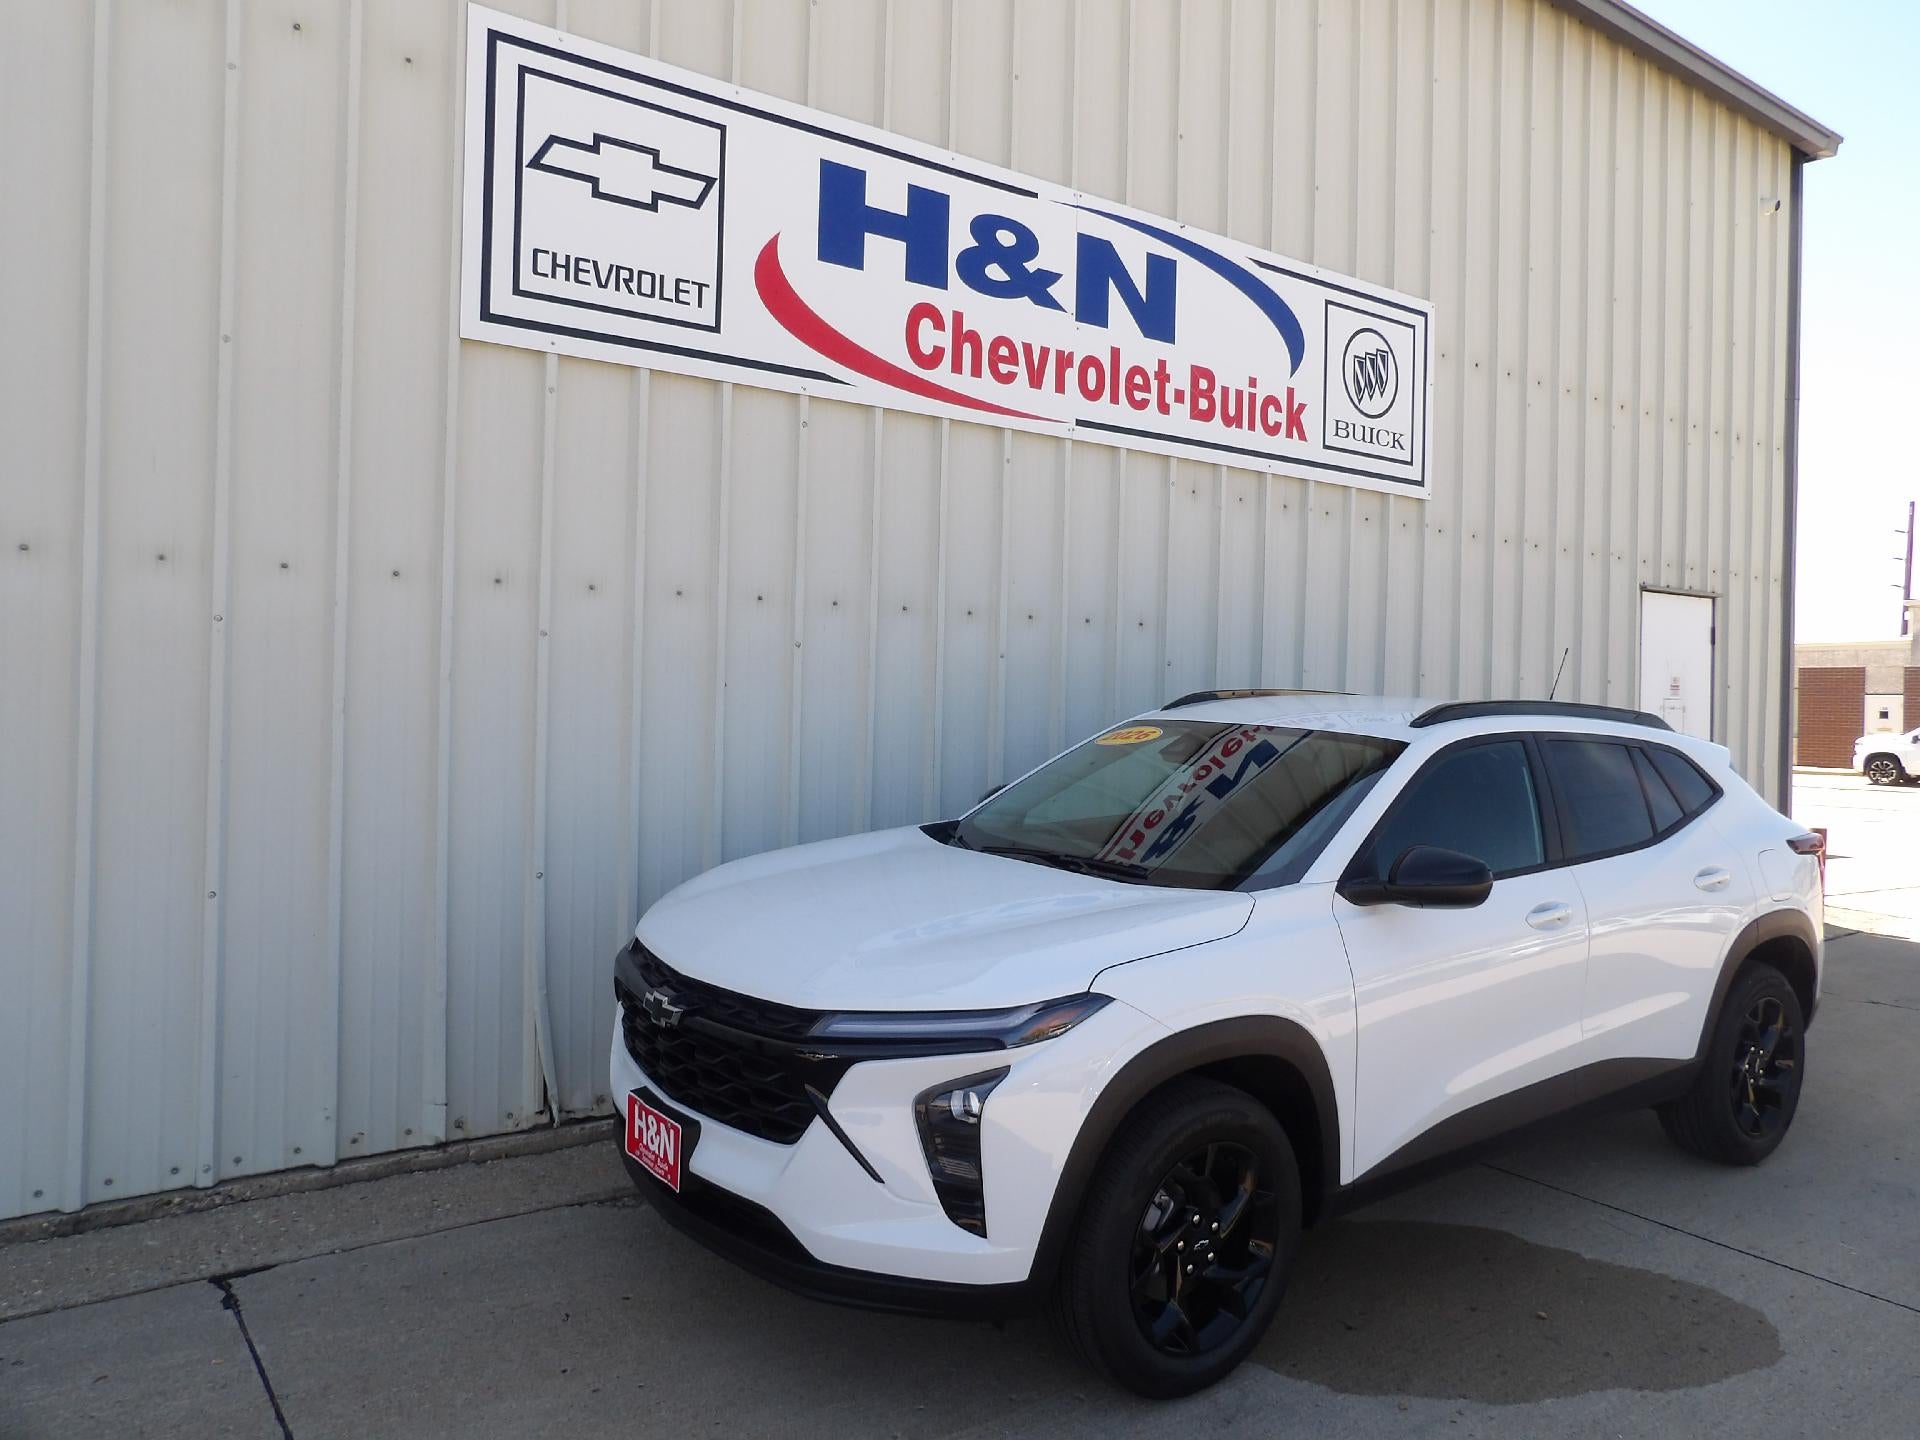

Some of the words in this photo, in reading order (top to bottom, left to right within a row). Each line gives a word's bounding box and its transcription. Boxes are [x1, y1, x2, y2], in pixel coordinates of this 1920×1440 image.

[532, 247, 710, 309] CHEVROLET
[818, 158, 1177, 344] H&N
[905, 302, 1308, 441] Chevrolet-Buick
[1333, 419, 1405, 451] BUICK
[634, 1103, 675, 1166] H&N
